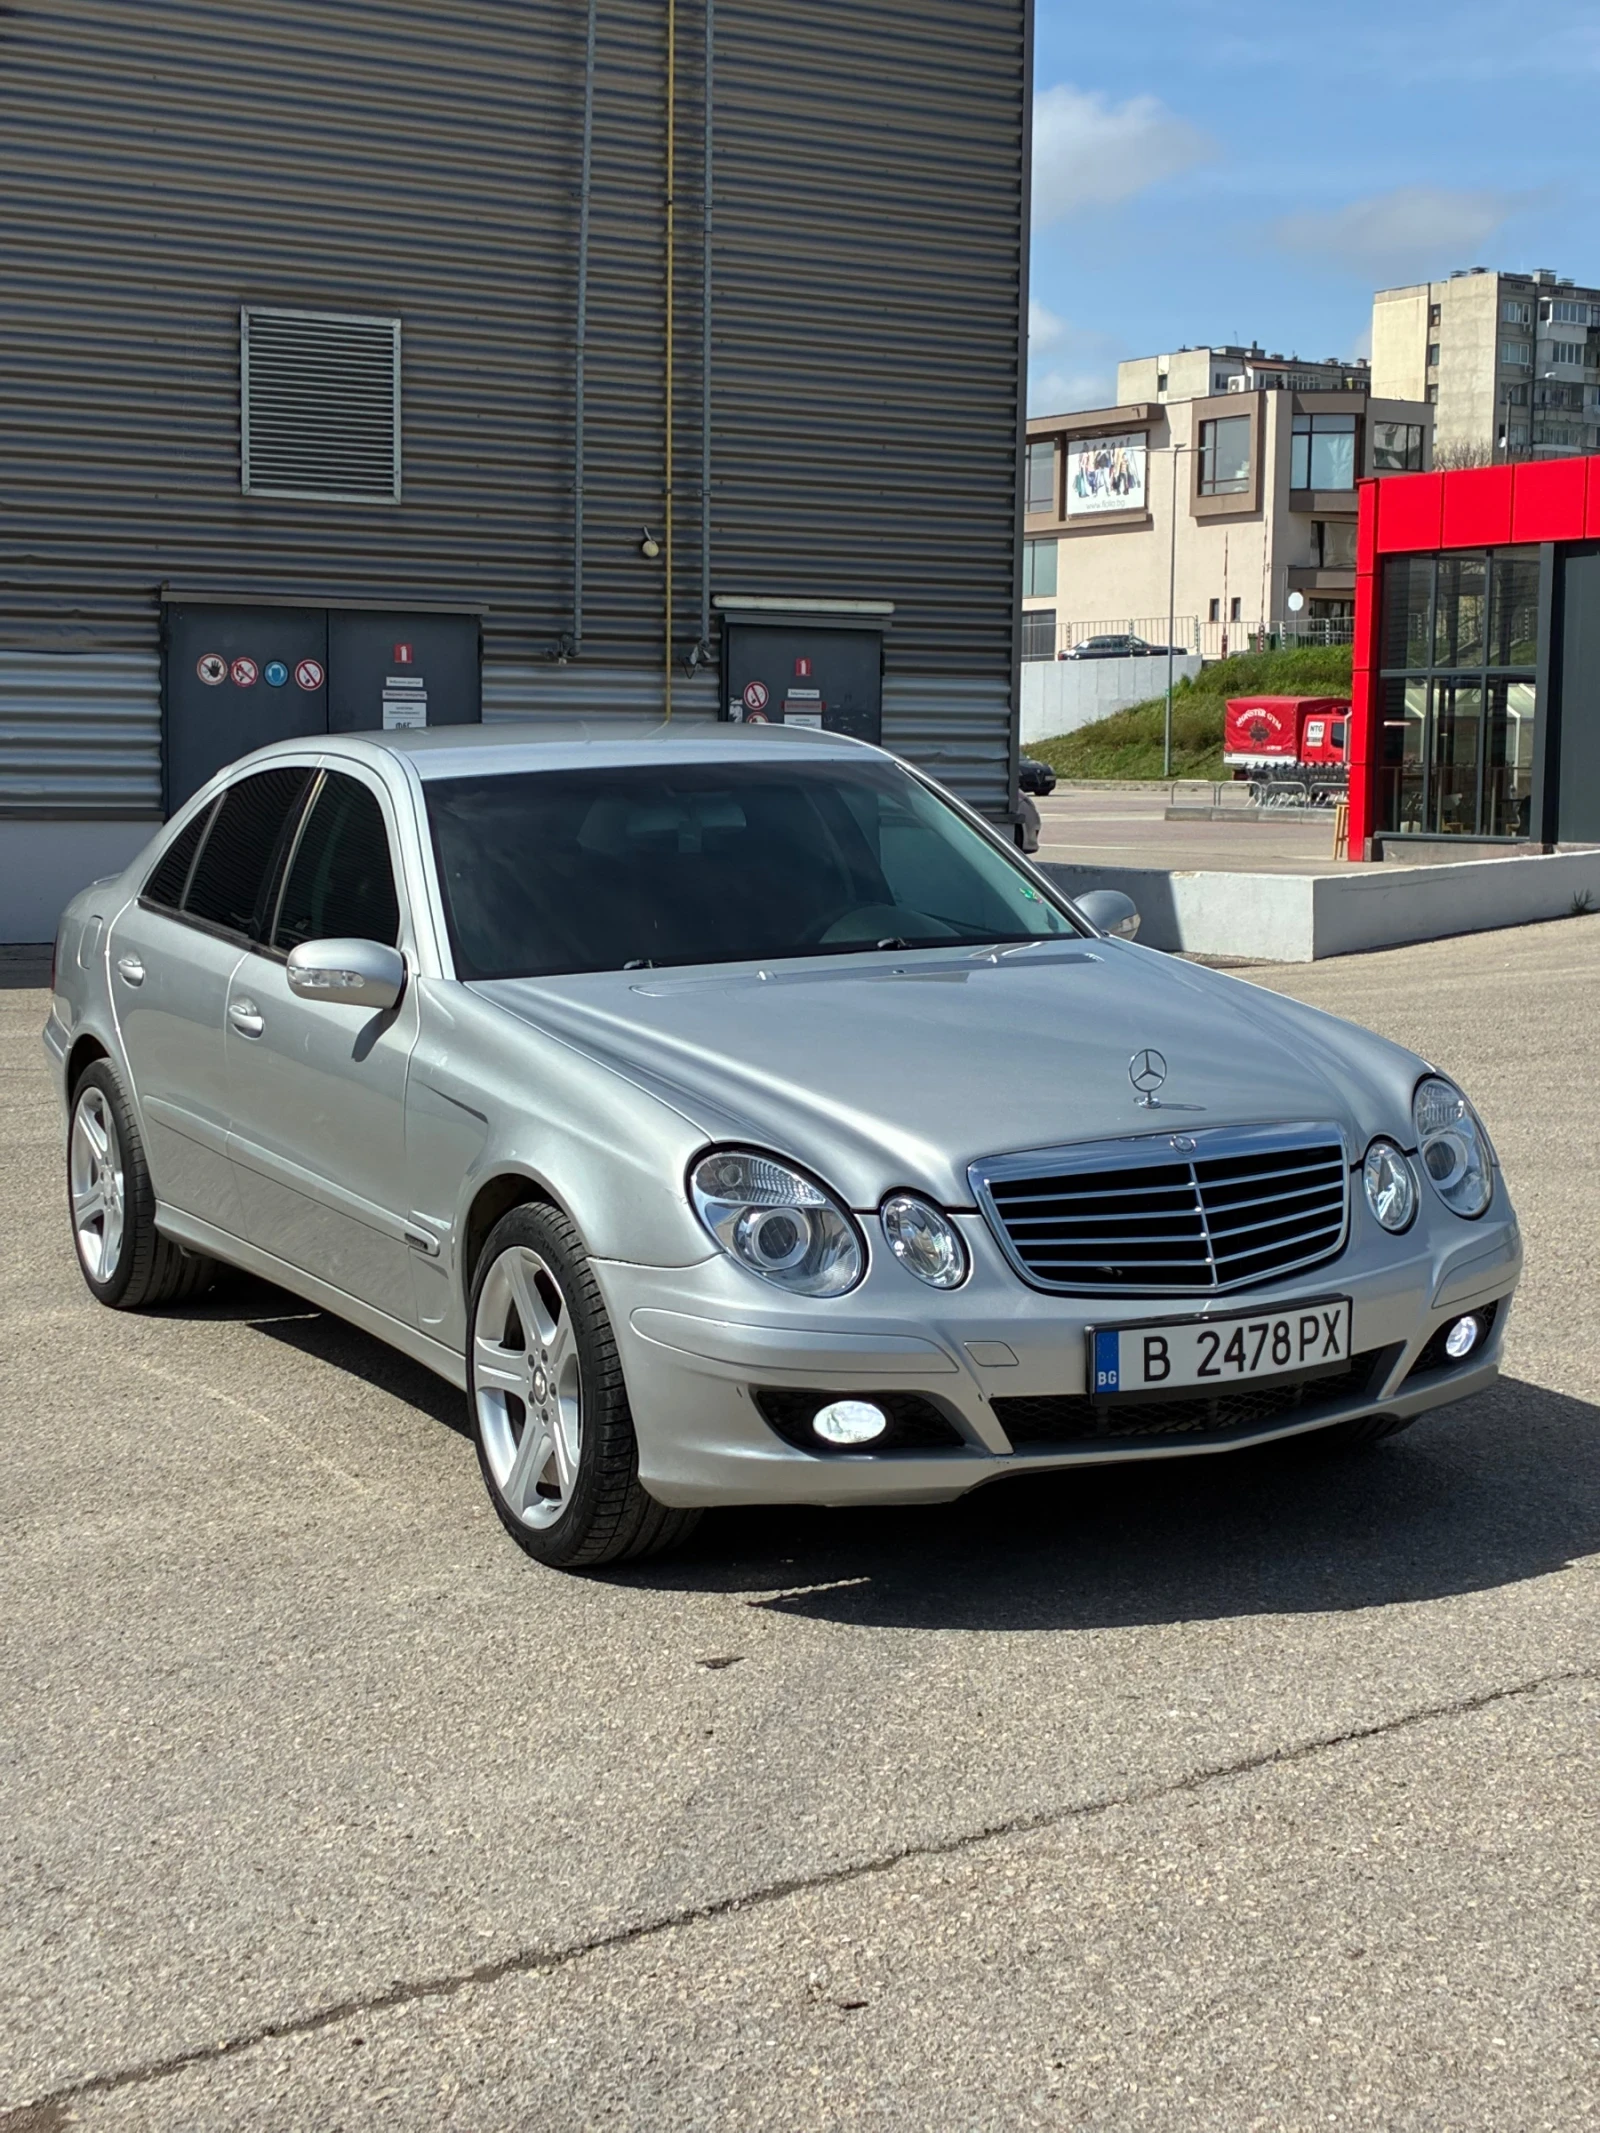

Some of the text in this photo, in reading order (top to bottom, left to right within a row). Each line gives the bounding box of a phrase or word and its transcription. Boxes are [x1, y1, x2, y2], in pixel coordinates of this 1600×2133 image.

[1236, 708, 1282, 731] MONSTER GYM
[1310, 724, 1323, 733] NTG
[1143, 1336, 1171, 1383] B
[1098, 1370, 1117, 1386] BG
